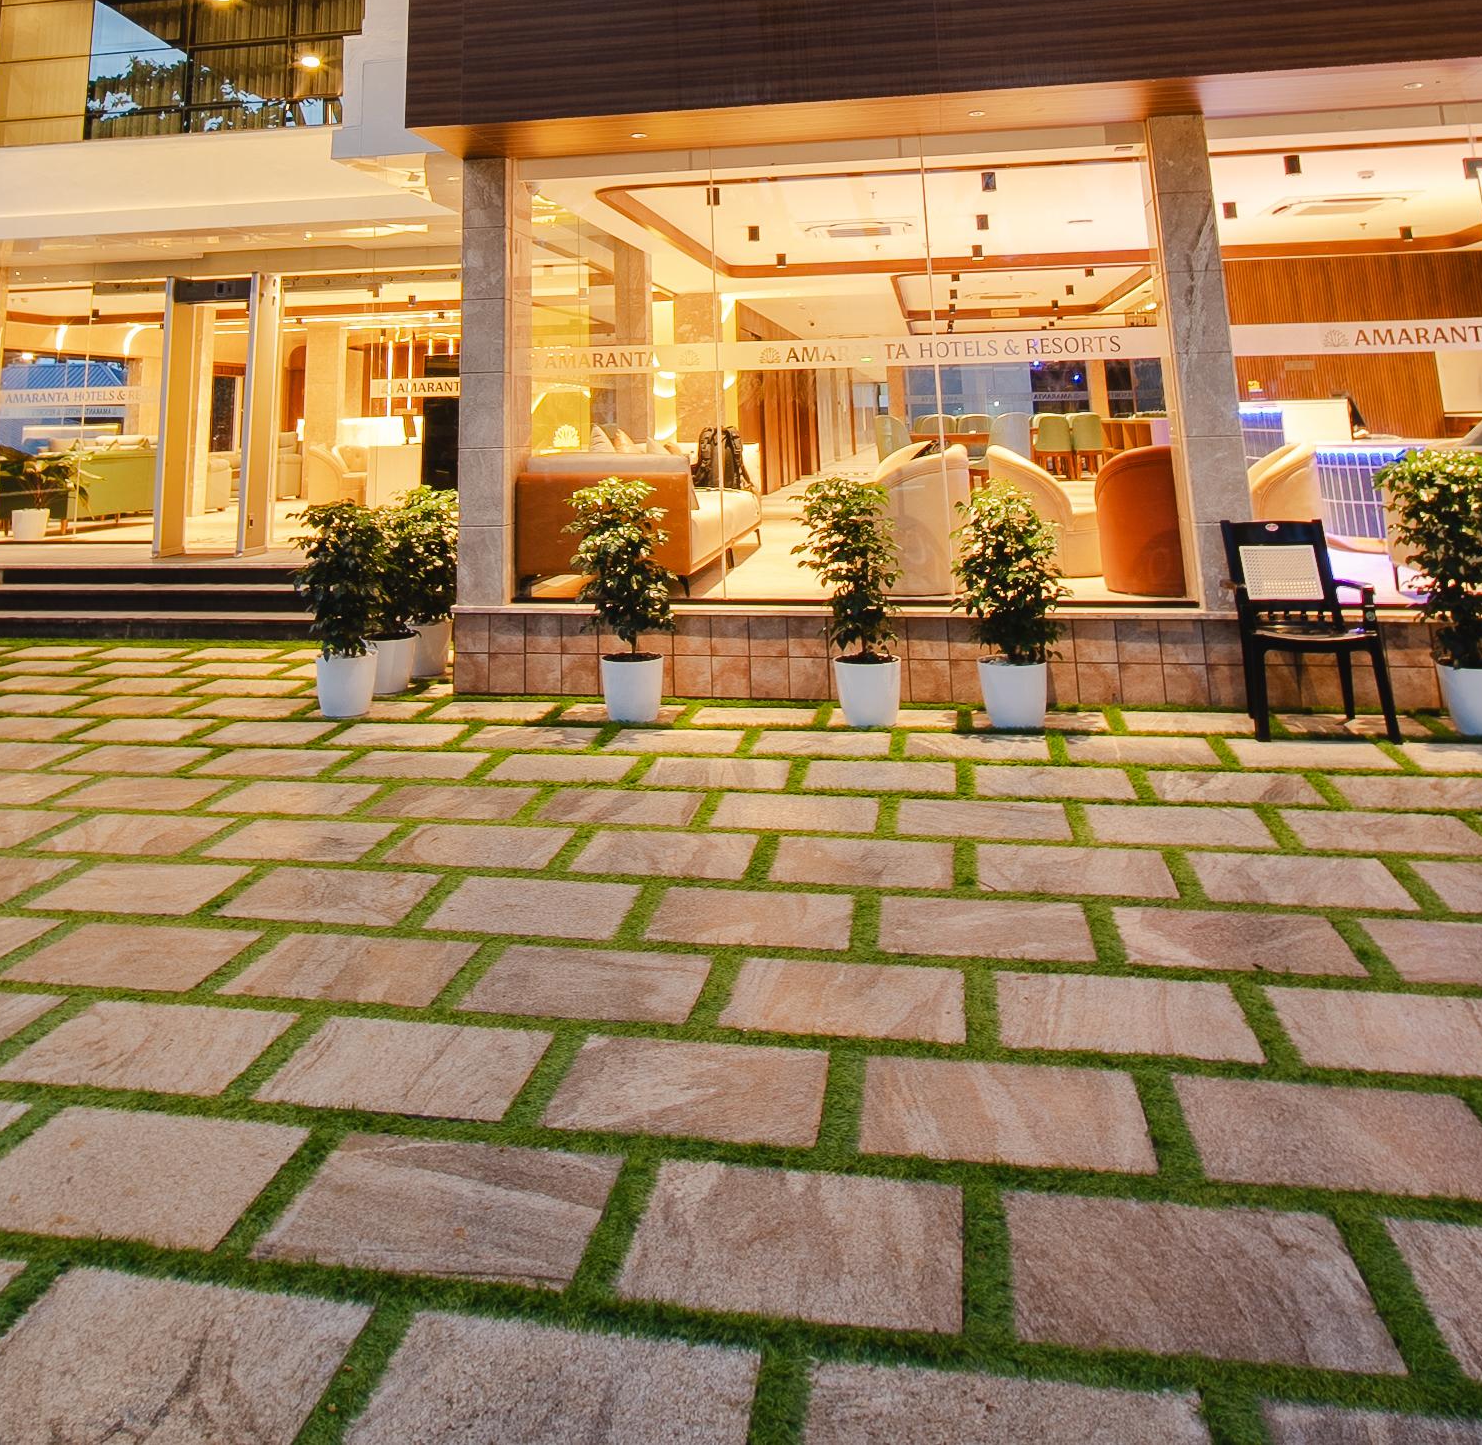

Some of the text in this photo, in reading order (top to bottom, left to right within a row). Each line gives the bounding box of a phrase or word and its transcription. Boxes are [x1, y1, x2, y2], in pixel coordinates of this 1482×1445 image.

[785, 335, 1122, 363] AMARTA HOTELS & RESORTS
[544, 351, 659, 369] AMARANTA
[5, 391, 69, 404] AMARANTA
[74, 390, 116, 403] HOTELS
[117, 391, 126, 401] &
